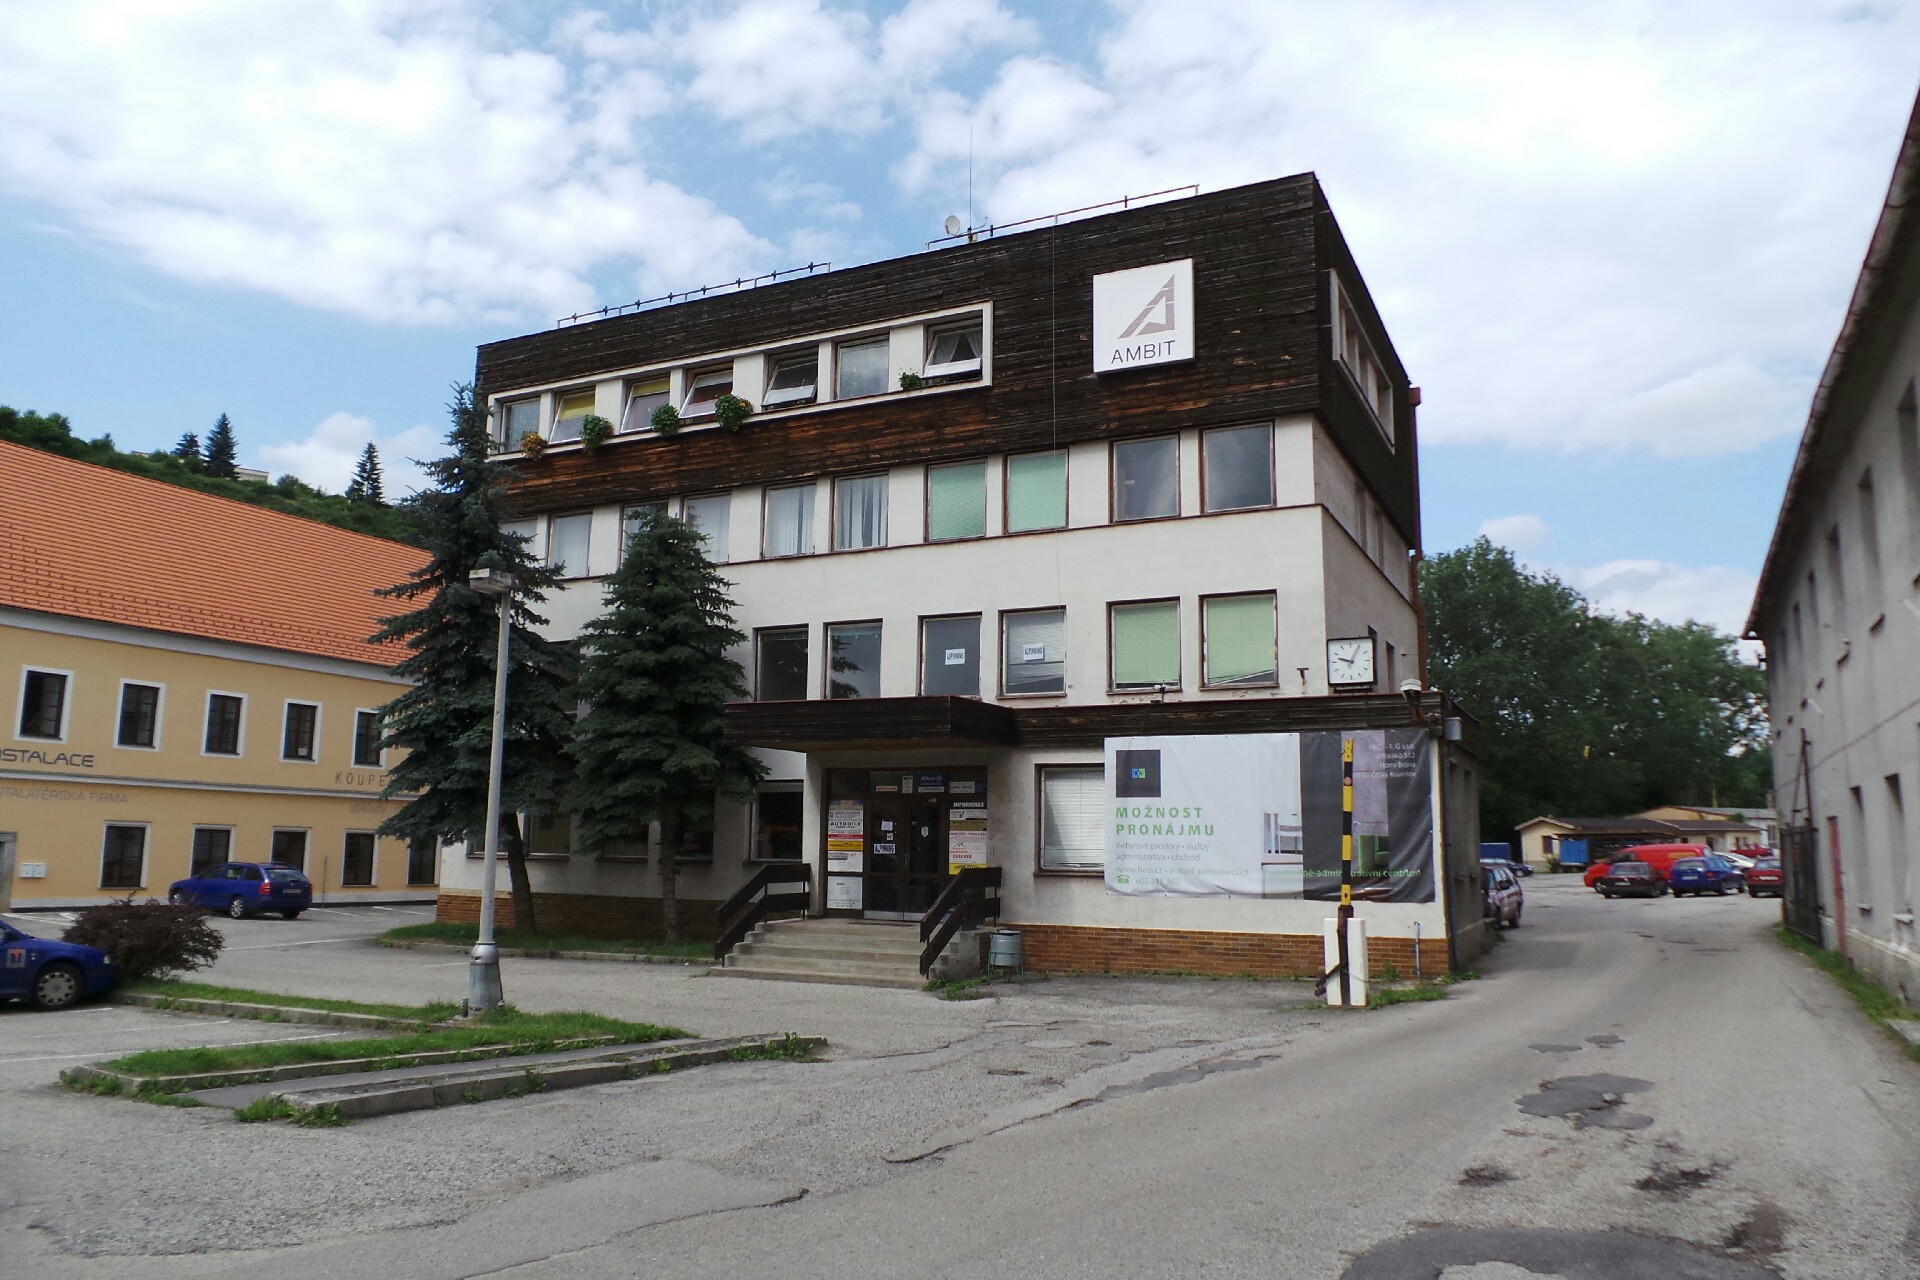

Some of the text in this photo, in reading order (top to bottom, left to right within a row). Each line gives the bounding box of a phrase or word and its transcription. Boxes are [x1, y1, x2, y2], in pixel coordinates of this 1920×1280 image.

[1111, 340, 1175, 364] AMBIT
[0, 748, 94, 768] STALACE
[89, 792, 128, 803] FIRMA
[1116, 805, 1202, 818] MOŽNOST
[1116, 822, 1214, 836] PRONÁJMU
[1116, 842, 1210, 852] nebytové prostory služby
[1170, 853, 1200, 861] obchod
